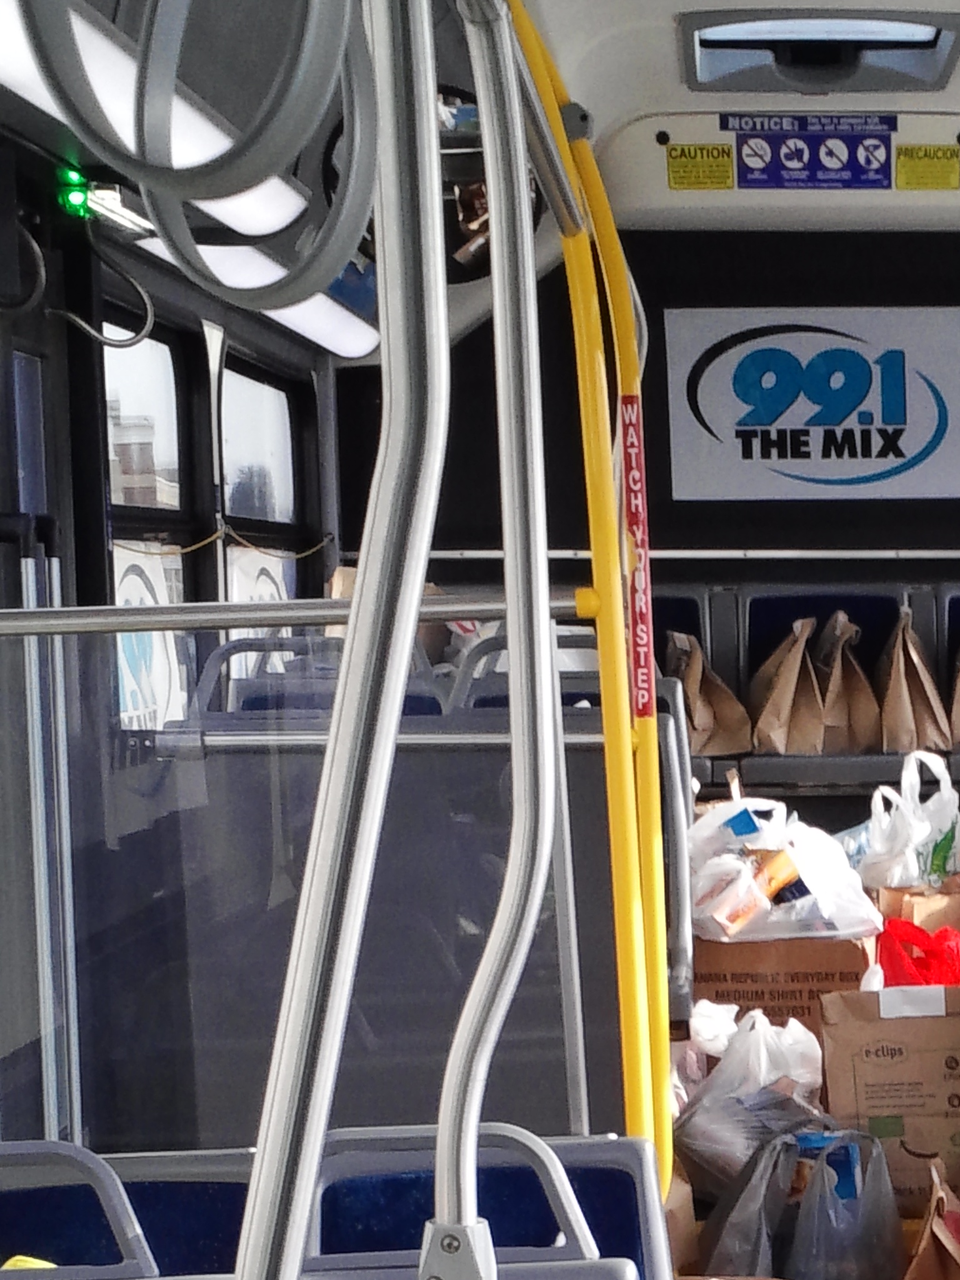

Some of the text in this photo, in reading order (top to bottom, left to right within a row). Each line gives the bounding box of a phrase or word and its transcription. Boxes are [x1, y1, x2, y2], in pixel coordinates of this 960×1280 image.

[669, 147, 731, 159] CAUTION
[732, 347, 907, 426] 99.1
[735, 427, 906, 460] THE MIX
[622, 403, 650, 710] WATCH YOUR STEP
[715, 989, 765, 1002] MEDIUM
